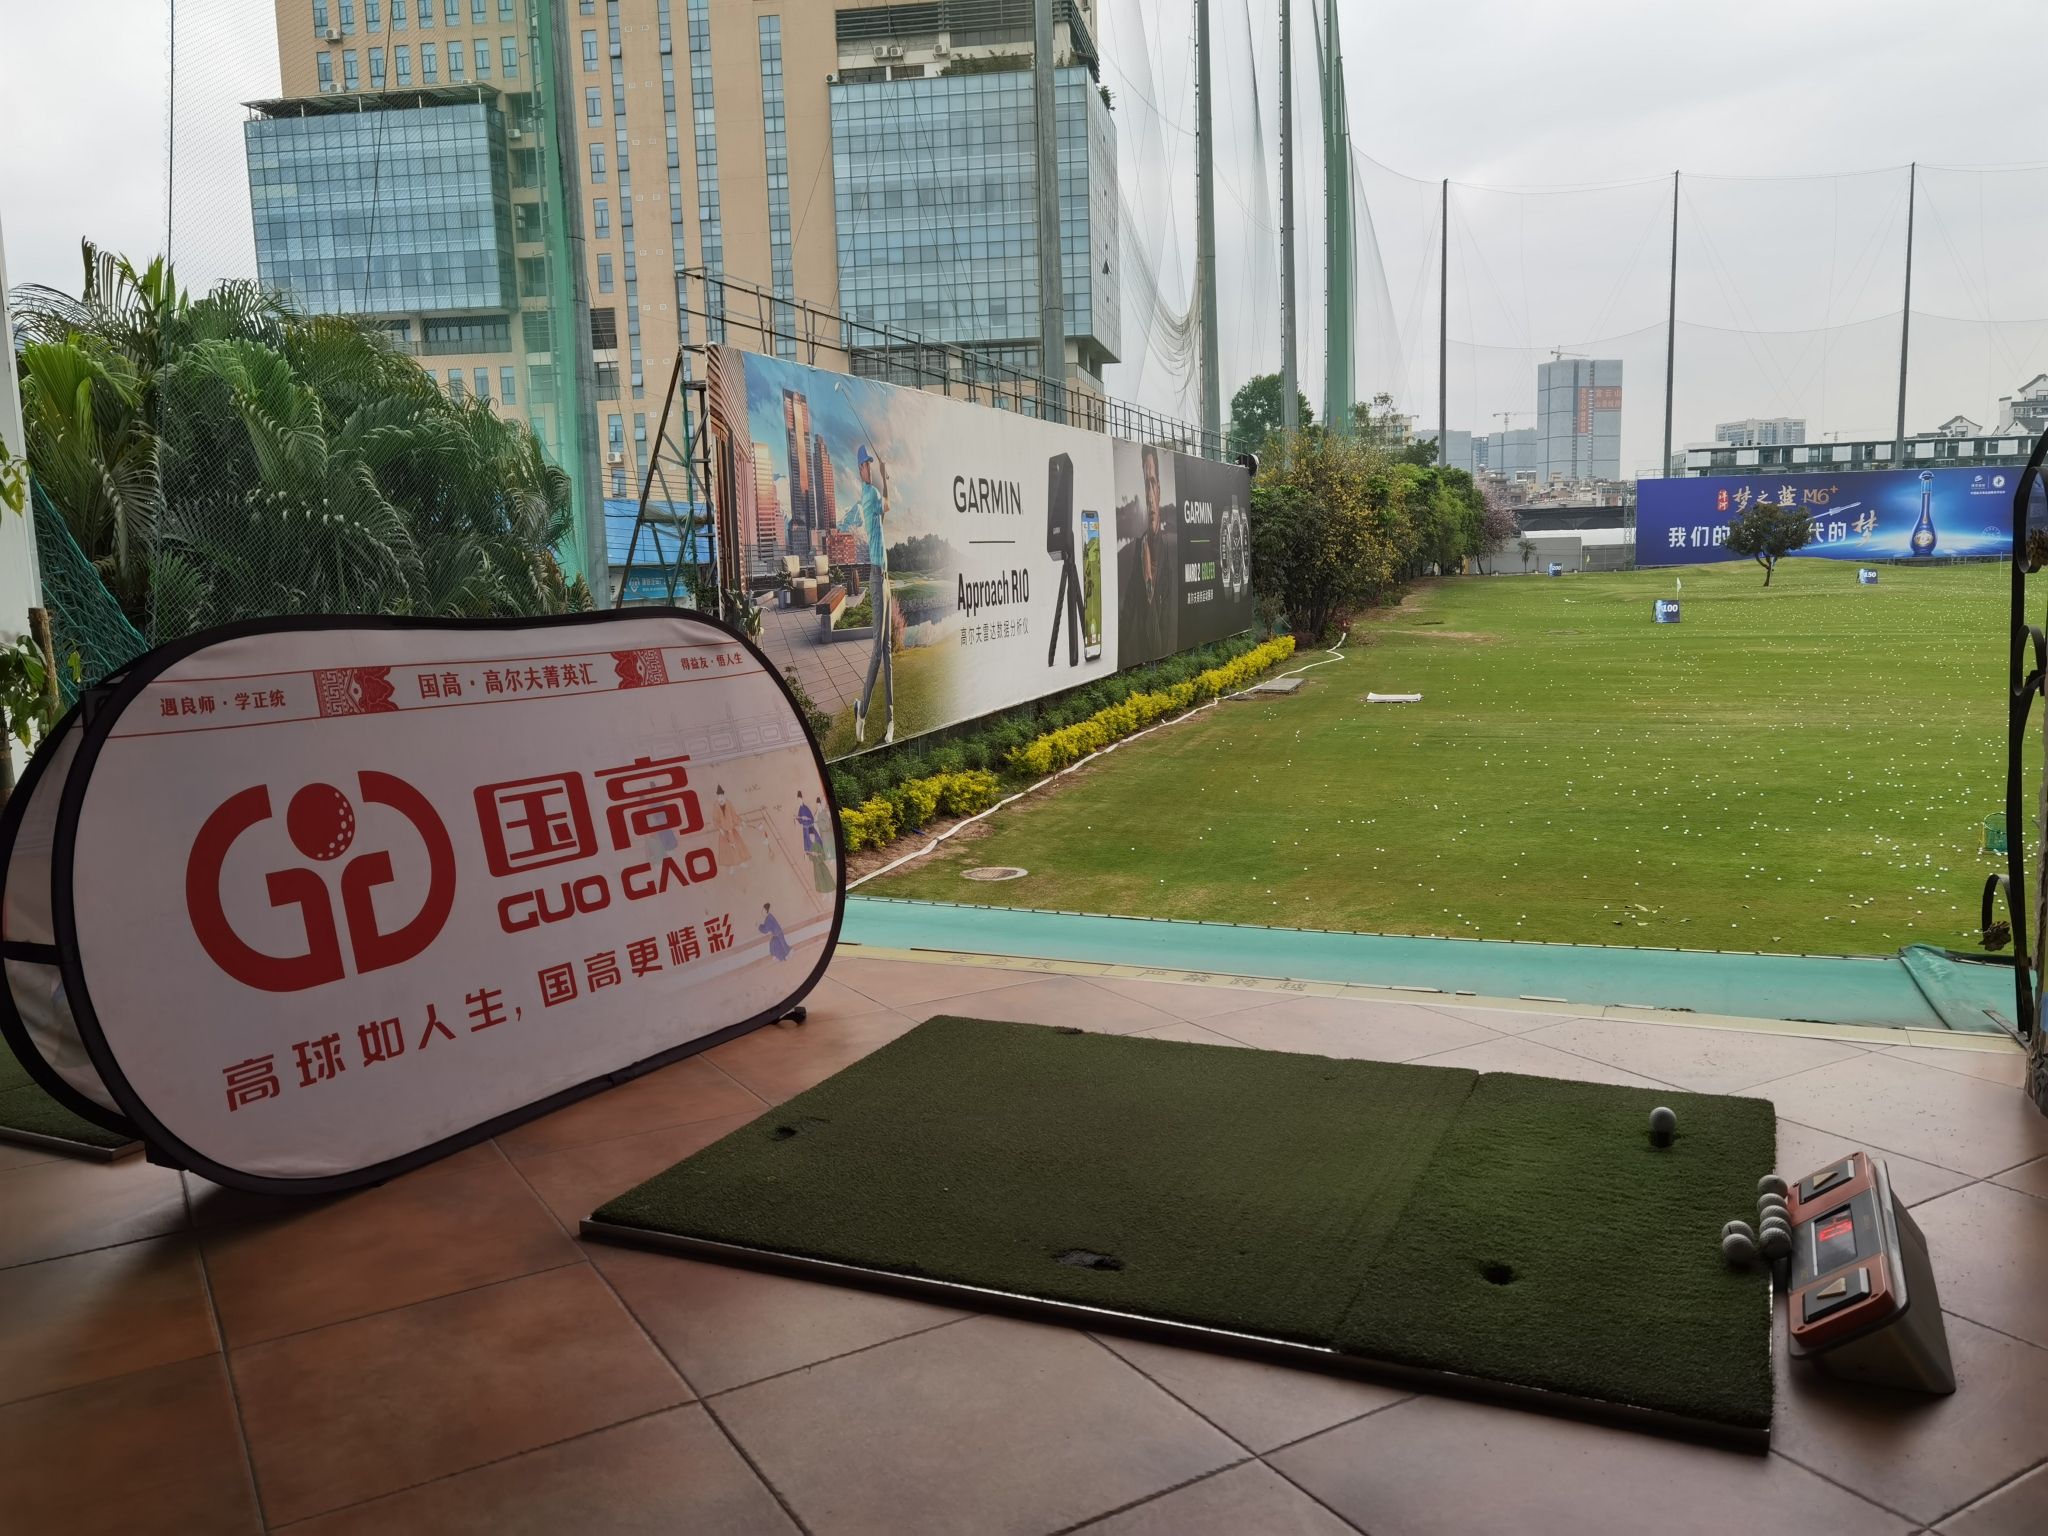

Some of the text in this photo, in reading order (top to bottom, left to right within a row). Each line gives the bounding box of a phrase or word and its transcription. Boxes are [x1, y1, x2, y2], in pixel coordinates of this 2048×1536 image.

[953, 475, 1023, 515] GARMIN
[1184, 500, 1213, 524] GARMIN
[1733, 485, 1797, 513] 梦之蓝
[957, 567, 1030, 618] Approach R10
[1662, 604, 1679, 613] 100
[960, 617, 1029, 647] 高尔夫雷达数据分析仪
[160, 689, 287, 717] 遇良师·学正统
[417, 662, 598, 700] 国高·高尔夫菁英汇
[473, 754, 705, 878] 国高
[497, 847, 718, 934] GUO GAO
